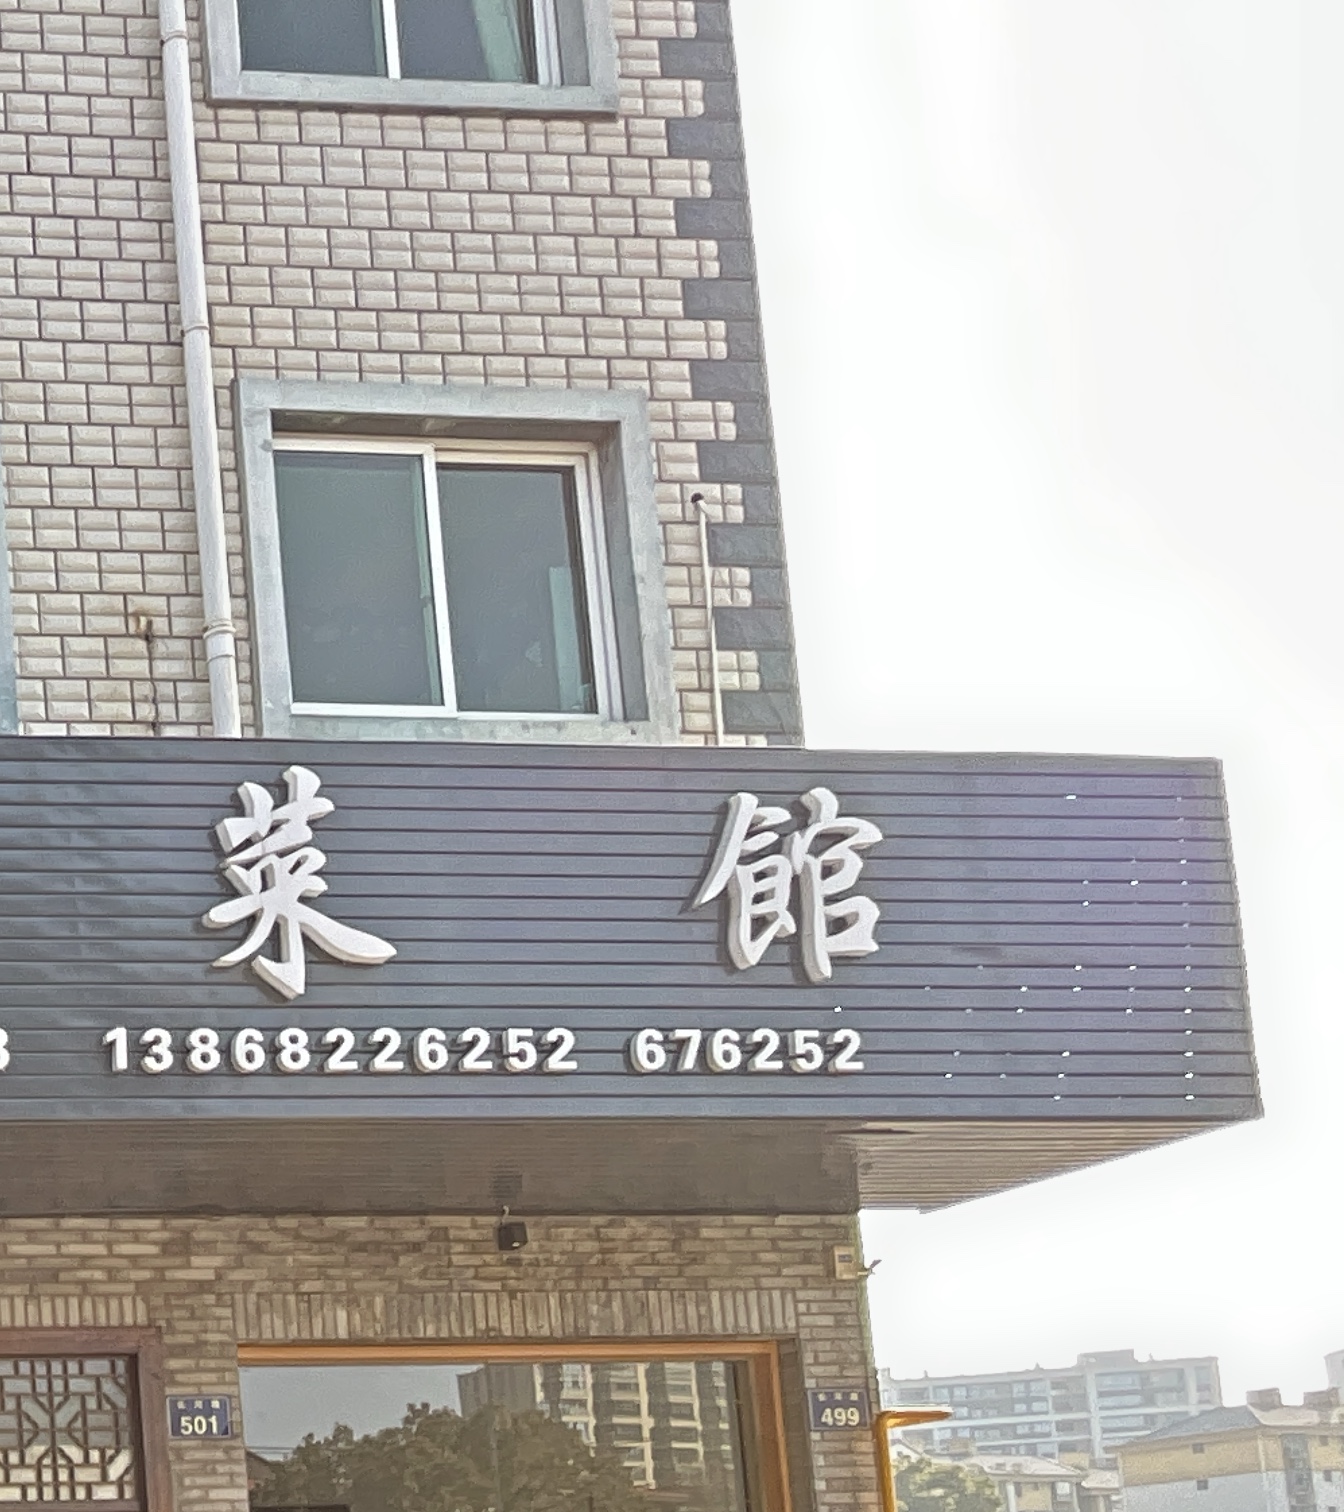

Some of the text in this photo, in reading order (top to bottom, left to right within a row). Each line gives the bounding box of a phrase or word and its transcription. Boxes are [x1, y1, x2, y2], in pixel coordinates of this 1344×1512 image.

[101, 1027, 578, 1073] 13868226252
[630, 1027, 865, 1073] 676252
[180, 1415, 218, 1435] 501
[820, 1407, 860, 1427] 499
